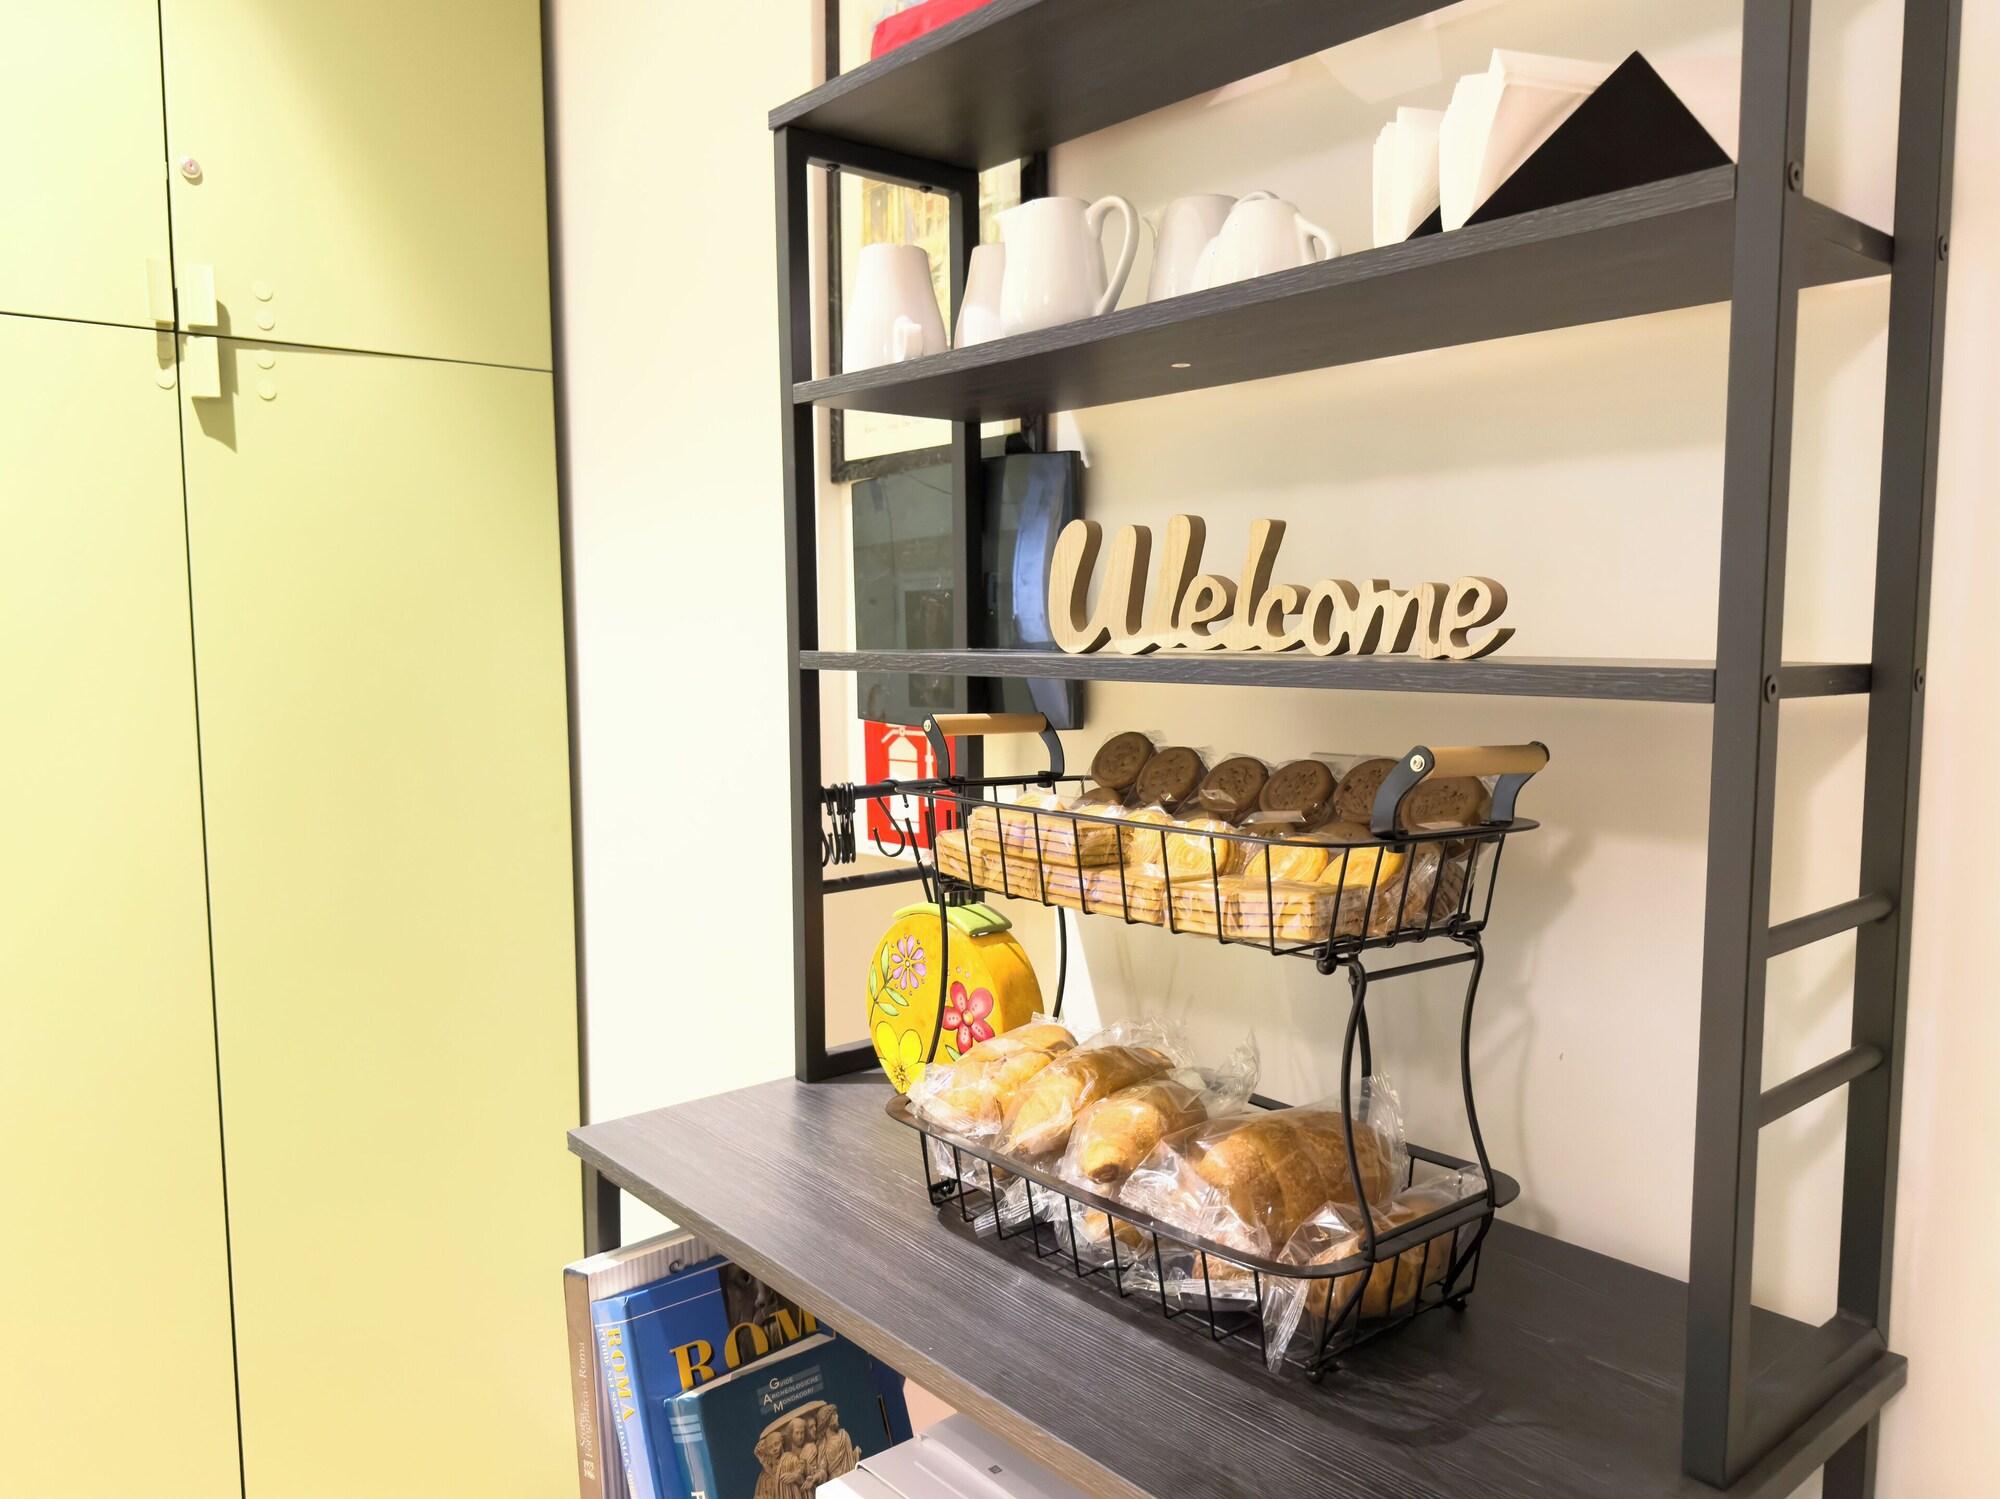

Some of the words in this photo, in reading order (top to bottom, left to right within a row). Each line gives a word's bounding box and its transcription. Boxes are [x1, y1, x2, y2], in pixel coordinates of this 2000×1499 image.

[1048, 514, 1516, 660] Welcome
[578, 1341, 587, 1378] Roma
[607, 1328, 636, 1421] ROMA
[669, 1308, 822, 1392] ROM
